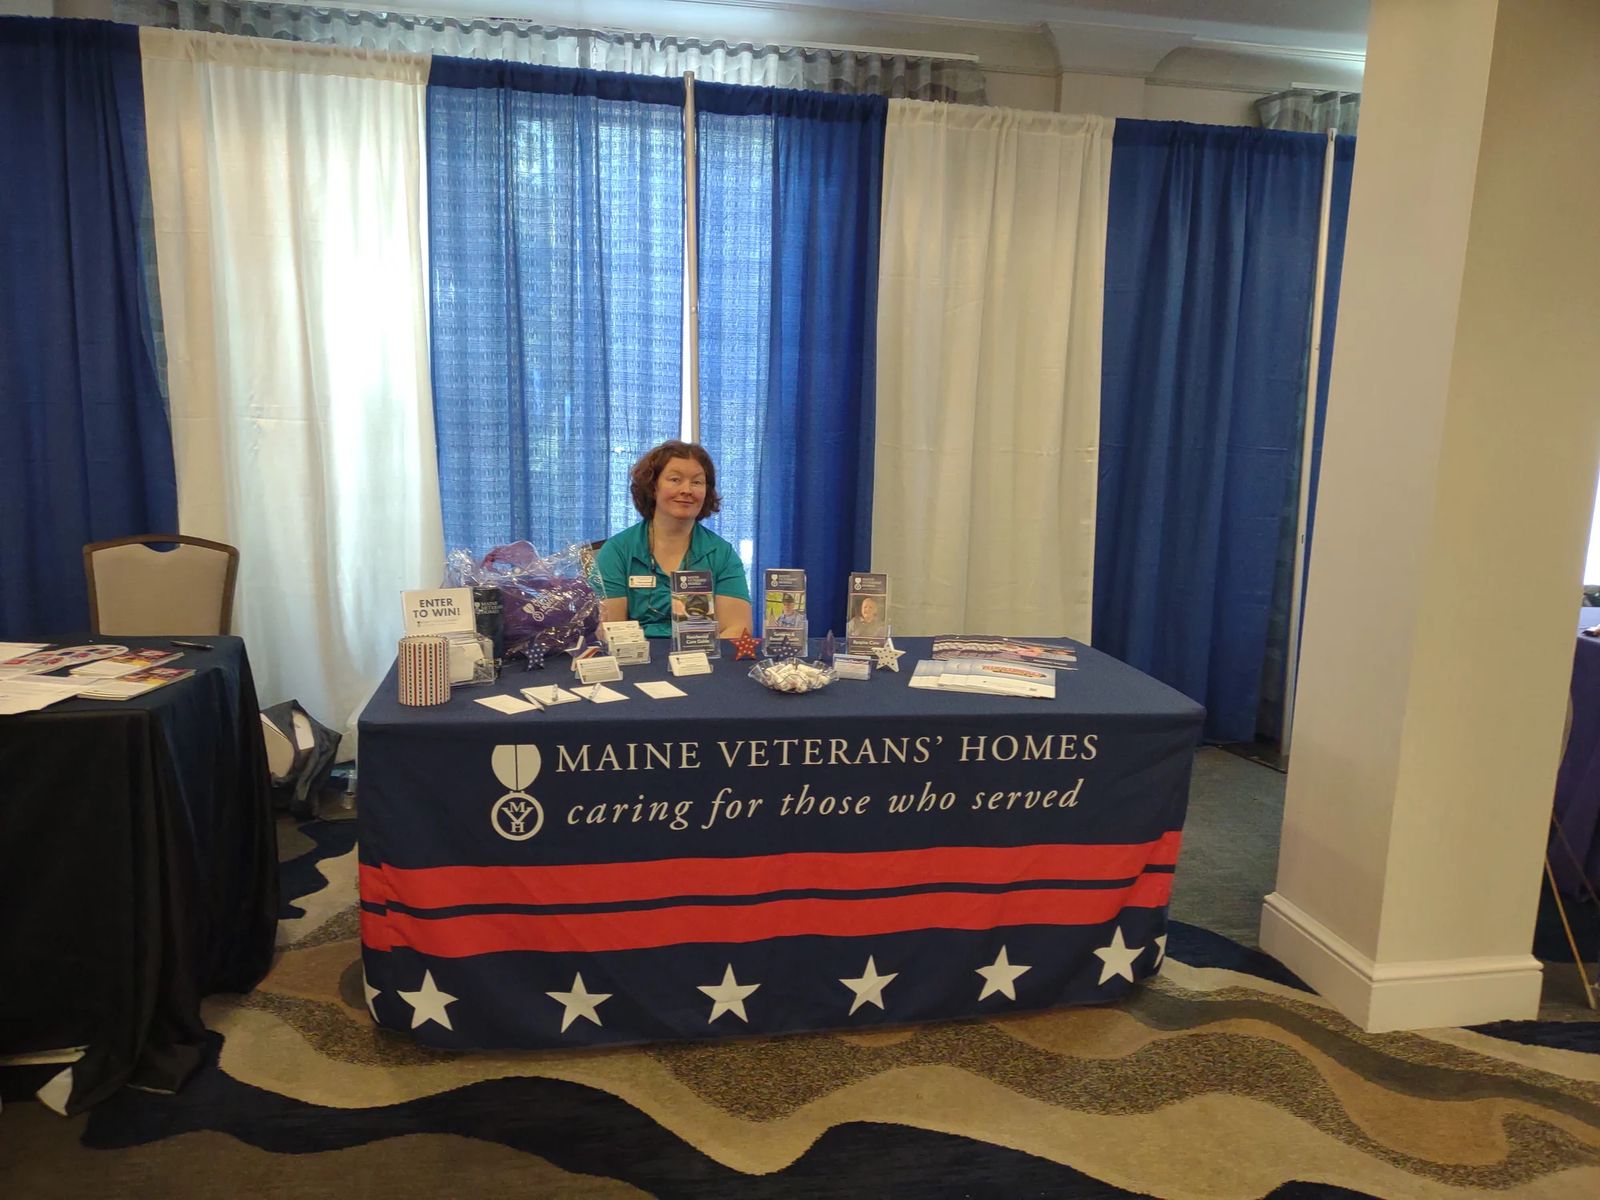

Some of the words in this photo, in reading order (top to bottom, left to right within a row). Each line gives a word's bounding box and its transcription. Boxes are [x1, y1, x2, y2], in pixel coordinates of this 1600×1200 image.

[412, 609, 428, 619] TO
[432, 607, 460, 617] WIN!
[419, 598, 453, 608] ENTER
[555, 741, 701, 773] MAINE
[716, 735, 944, 769] VETERANS’
[958, 734, 1099, 763] HOMES
[567, 794, 694, 831] caring
[700, 786, 764, 831] for
[779, 783, 871, 817] those
[888, 781, 957, 813] who
[972, 778, 1085, 811] served
